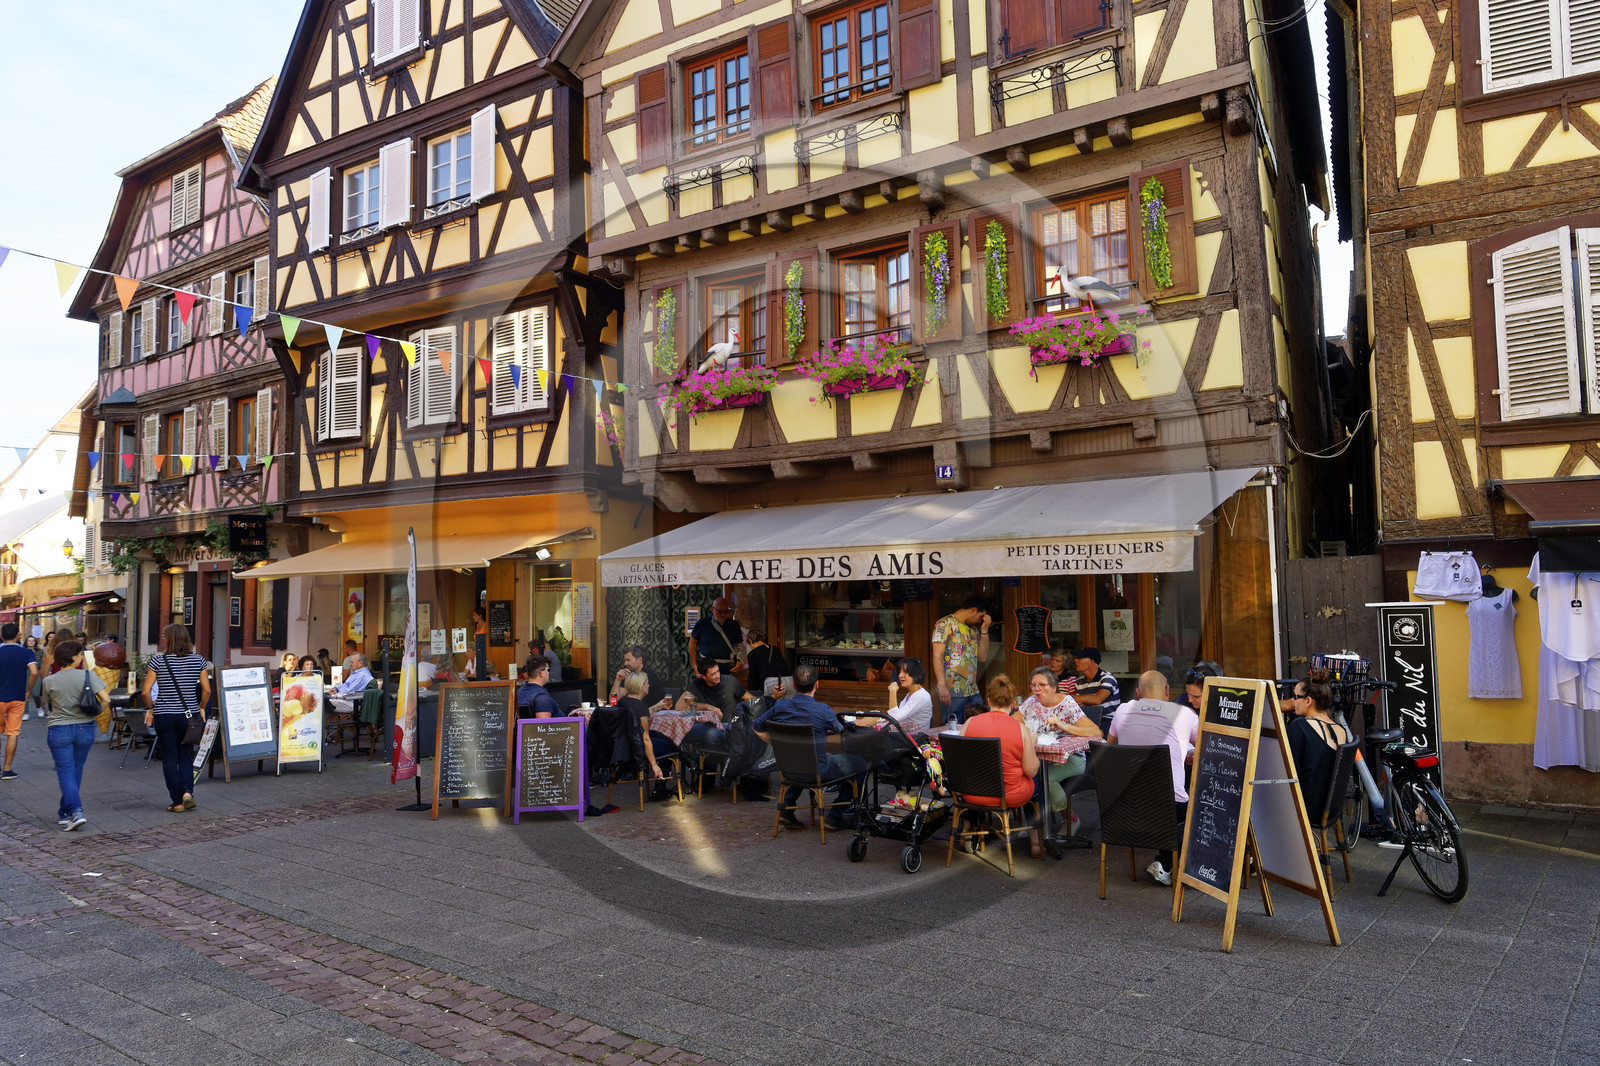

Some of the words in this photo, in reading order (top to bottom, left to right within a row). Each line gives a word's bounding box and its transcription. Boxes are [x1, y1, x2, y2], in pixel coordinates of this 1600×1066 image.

[939, 466, 951, 477] 14
[232, 520, 262, 530] Meyer's
[1007, 544, 1060, 557] PETITS
[1064, 541, 1164, 558] DEJEUNERS
[630, 563, 665, 573] GLACES
[716, 559, 783, 580] CAFE
[796, 555, 852, 578] DES
[867, 551, 944, 576] AMIS
[1042, 558, 1123, 570] TARTINES
[617, 573, 678, 584] ARTISANALES
[800, 657, 829, 665] Glaces
[1394, 656, 1428, 694] Nil
[1218, 696, 1243, 710] Minute
[1220, 708, 1238, 720] Maid
[1400, 700, 1427, 728] du
